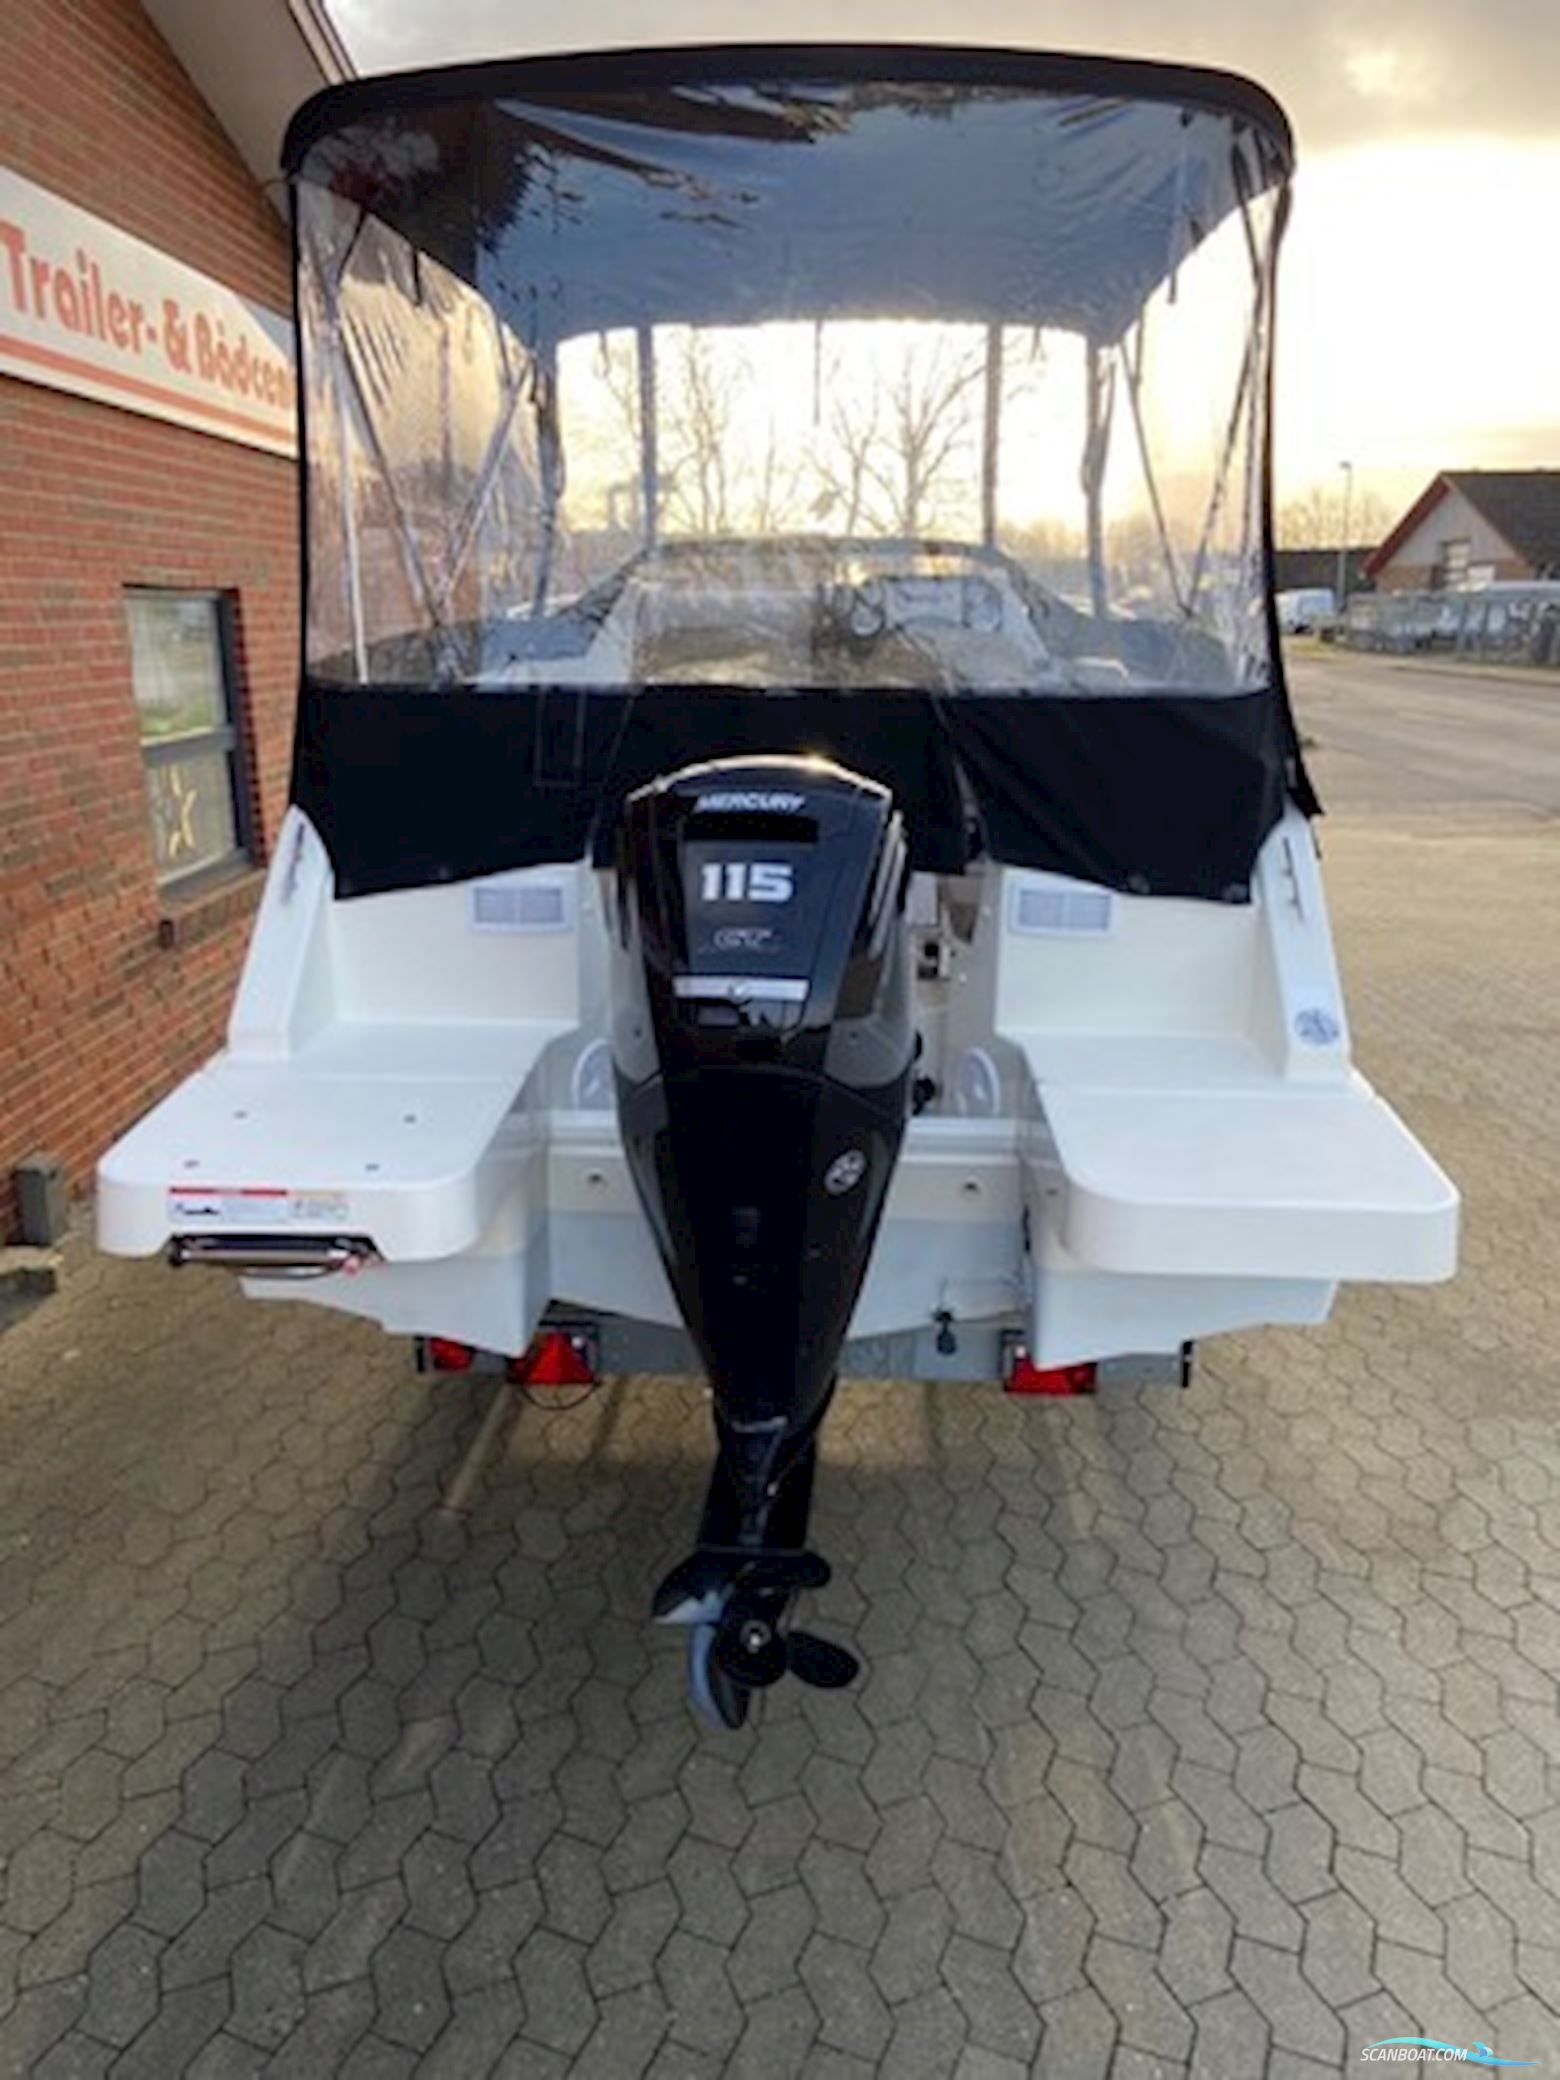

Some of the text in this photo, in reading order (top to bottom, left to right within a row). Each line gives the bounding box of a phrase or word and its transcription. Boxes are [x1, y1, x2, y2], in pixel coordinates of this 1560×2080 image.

[162, 298, 192, 375] &
[693, 791, 806, 813] MERCURY
[701, 863, 793, 902] 115
